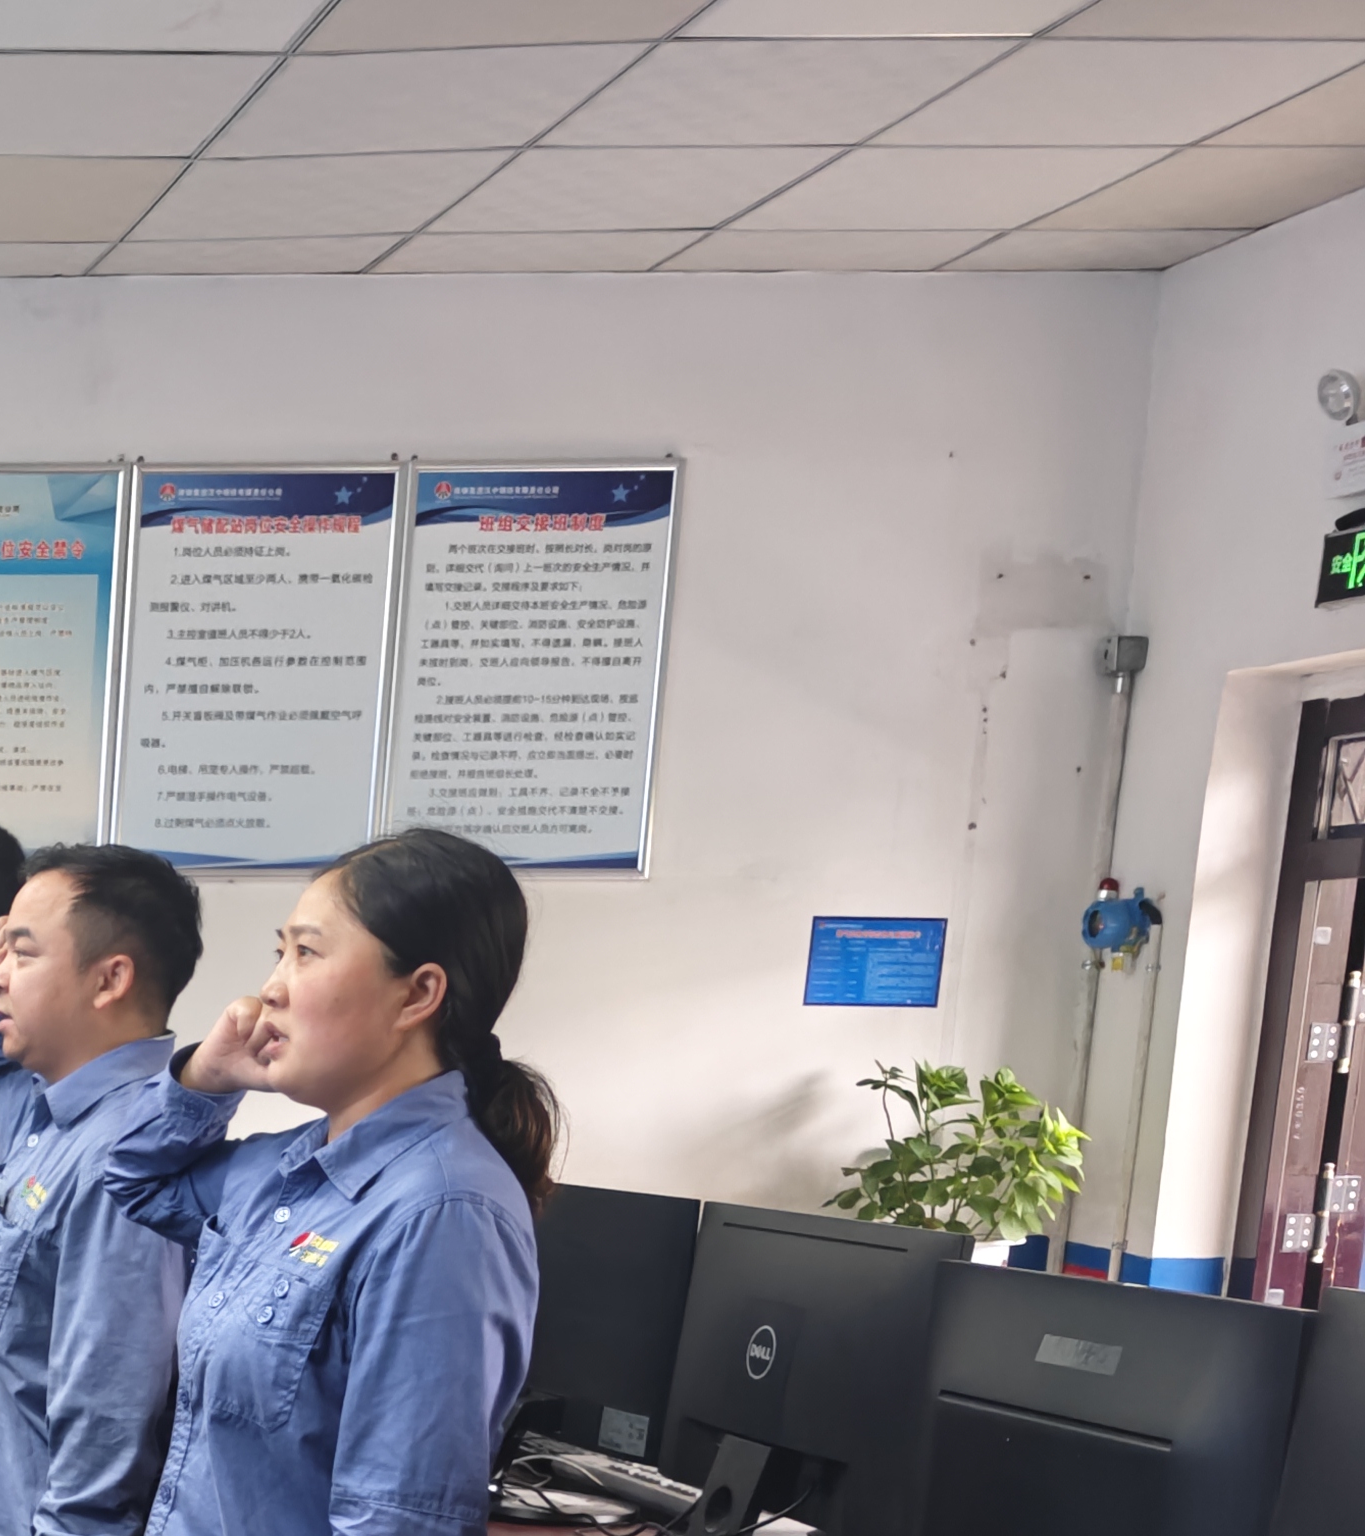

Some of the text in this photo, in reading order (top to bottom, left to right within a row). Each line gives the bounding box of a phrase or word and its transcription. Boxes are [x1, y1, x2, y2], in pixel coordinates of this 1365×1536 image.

[171, 515, 362, 534] 煤气储配站岗位安全操作规程
[478, 513, 606, 532] 班组交接班制度
[174, 546, 290, 557] 1.岗位人员必须持证上岗。
[1330, 552, 1353, 575] 安全
[417, 677, 441, 686] 岗位。
[140, 738, 166, 749] 吸器。
[750, 1343, 771, 1361] DELL
